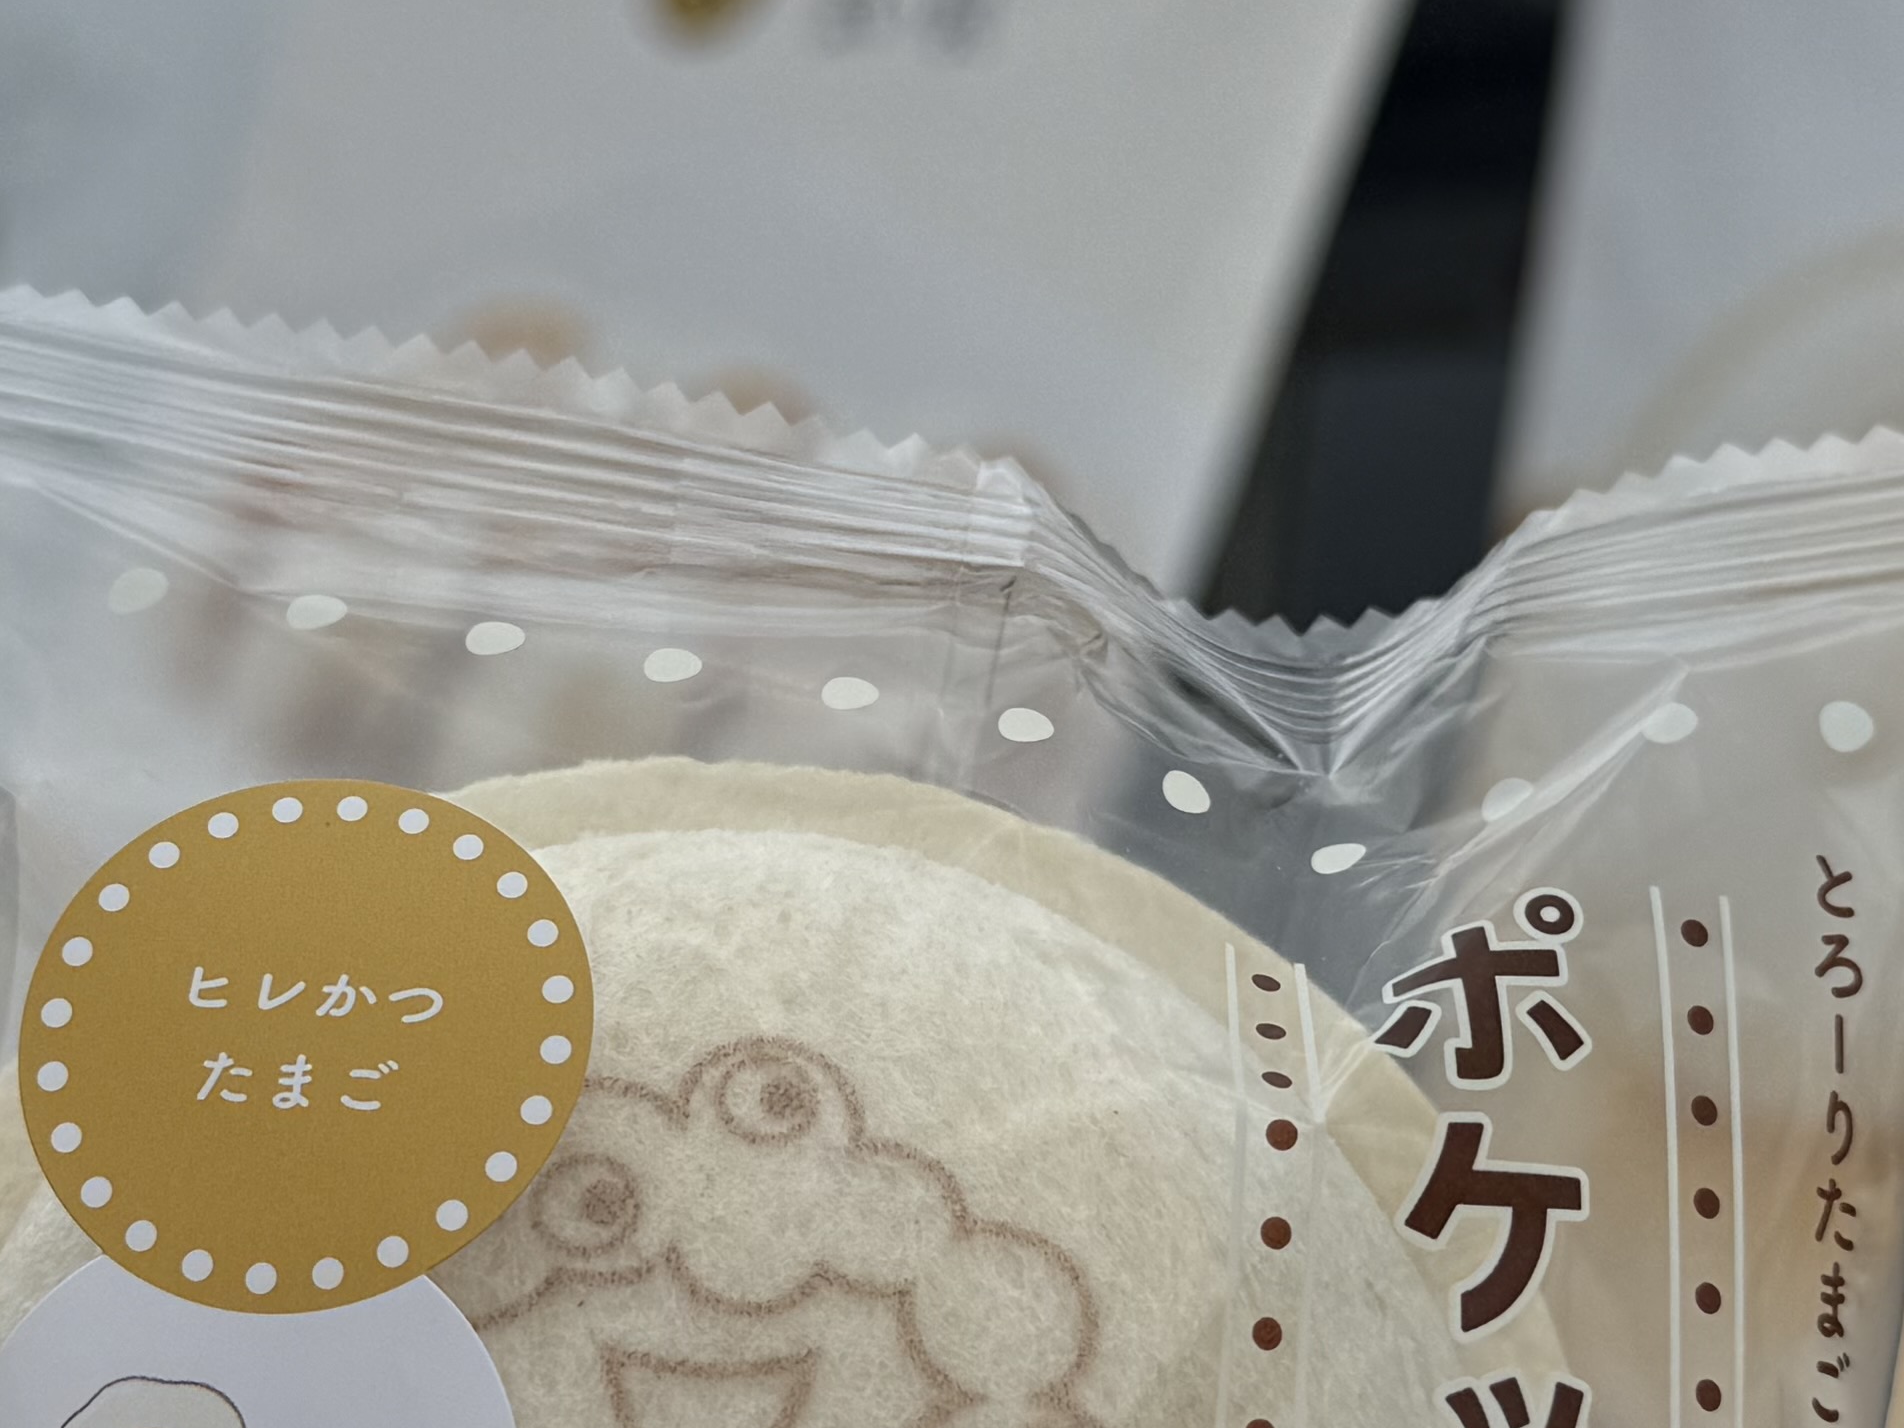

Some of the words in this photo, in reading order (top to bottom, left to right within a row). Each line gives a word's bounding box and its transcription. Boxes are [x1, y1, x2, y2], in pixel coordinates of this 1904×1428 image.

[187, 966, 444, 1024] ヒレかつ
[195, 1051, 400, 1111] たまご
